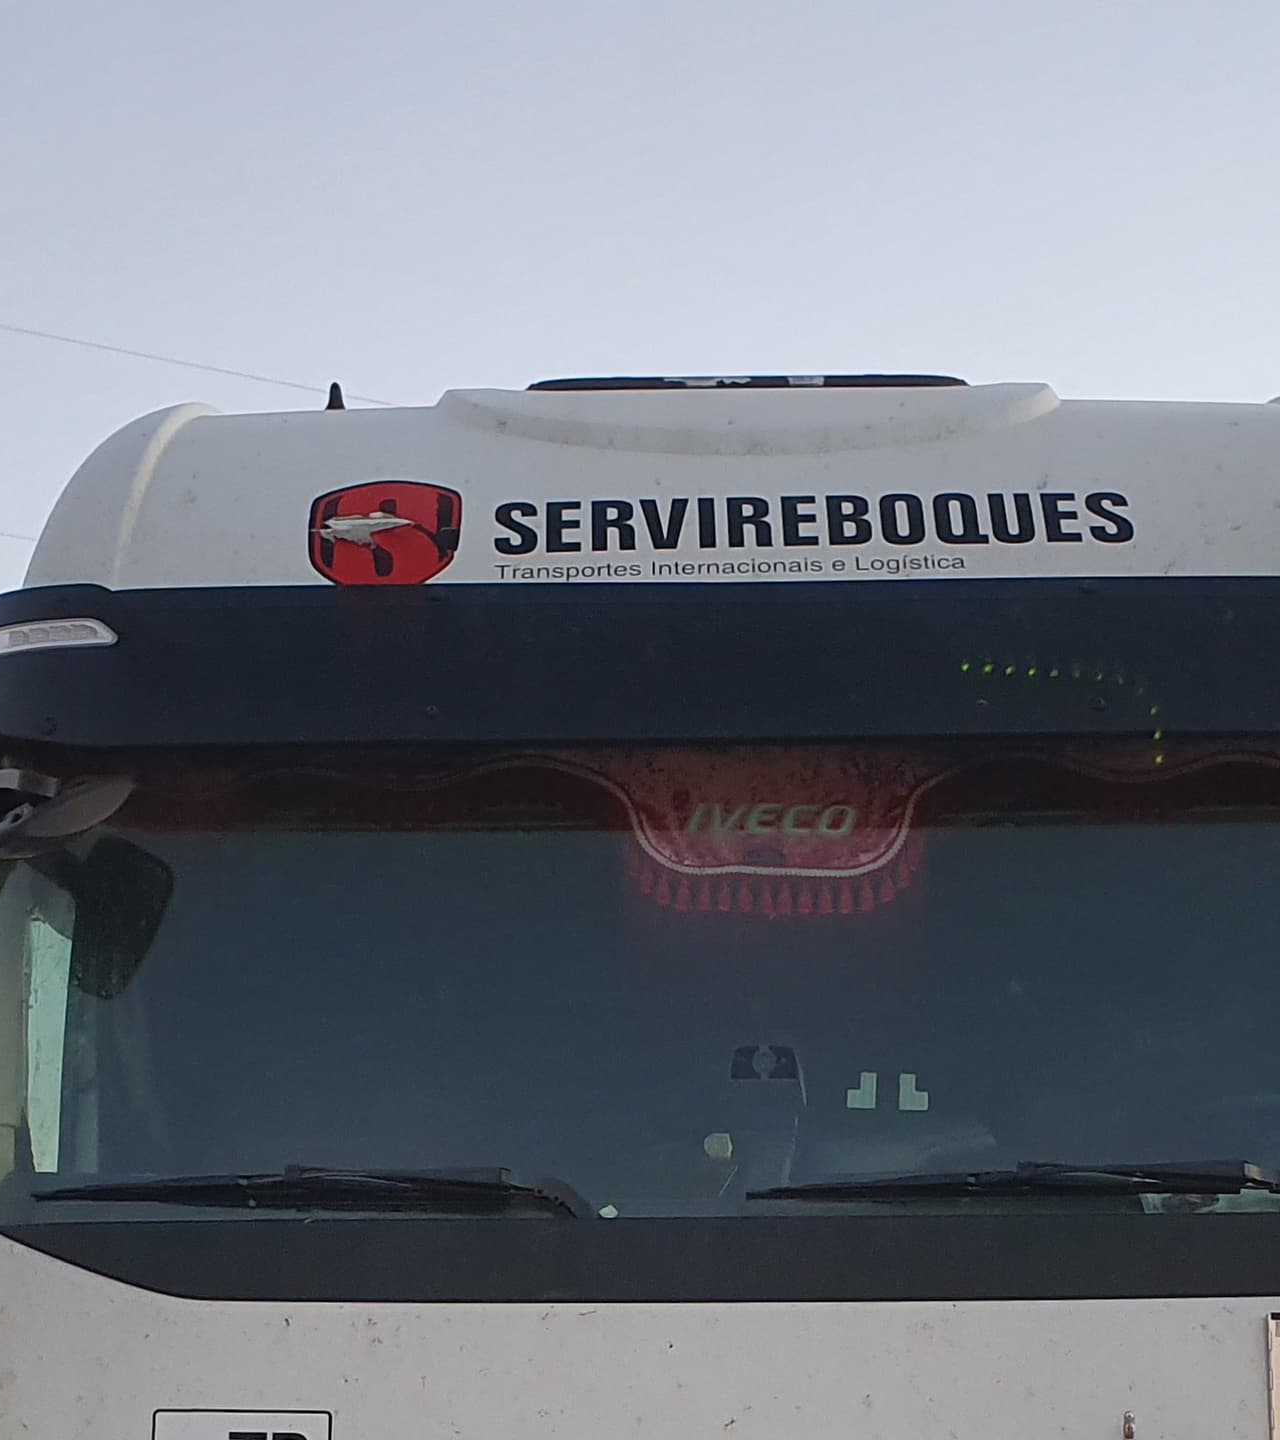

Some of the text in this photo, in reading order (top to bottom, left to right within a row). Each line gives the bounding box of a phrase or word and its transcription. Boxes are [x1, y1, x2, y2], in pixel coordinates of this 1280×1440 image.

[494, 492, 1134, 555] SERVIREBOQUES
[494, 554, 966, 581] Transportes Internacionais e Logística
[688, 801, 858, 837] IVECO
